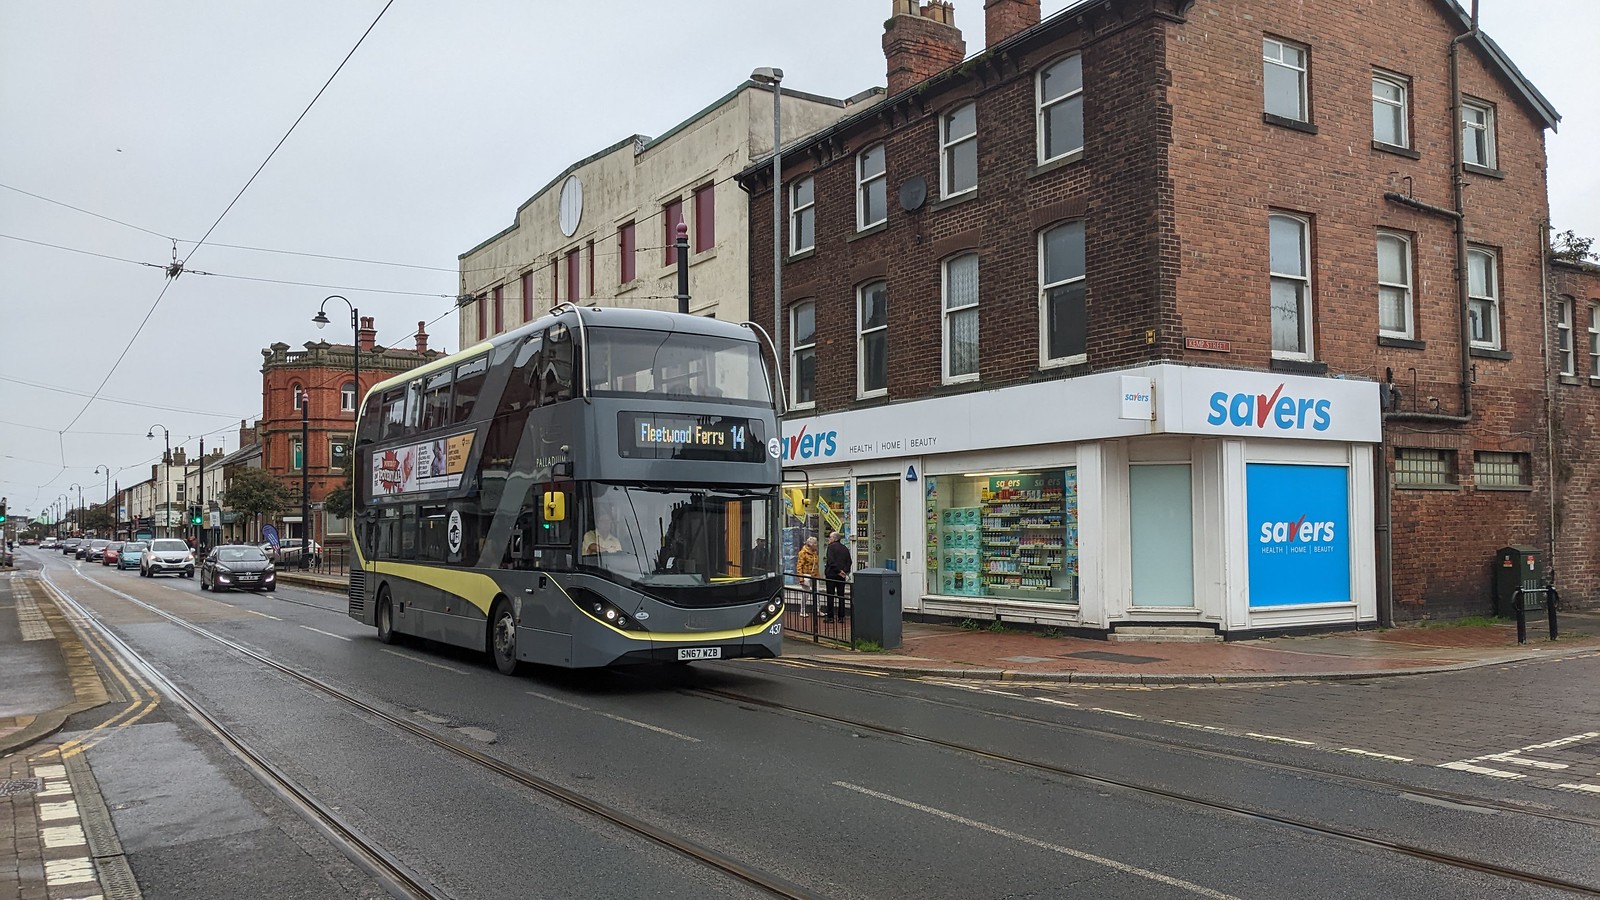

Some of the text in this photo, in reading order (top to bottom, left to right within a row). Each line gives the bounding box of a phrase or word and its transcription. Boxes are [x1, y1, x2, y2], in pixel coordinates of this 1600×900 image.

[1188, 340, 1226, 350] KEMP STREET
[1125, 393, 1149, 402] savers
[1207, 383, 1331, 431] savers
[641, 423, 745, 449] Fleetwood Ferry 14
[782, 424, 837, 460] avers
[850, 444, 873, 453] HEALTH
[881, 441, 901, 450] HOME
[910, 437, 937, 448] BEAUTY
[536, 456, 566, 468] PALLADIUM
[1260, 514, 1335, 543] savers
[1262, 546, 1283, 554] HEALTH
[769, 624, 781, 635] 437
[681, 650, 718, 659] SN67 WZB
